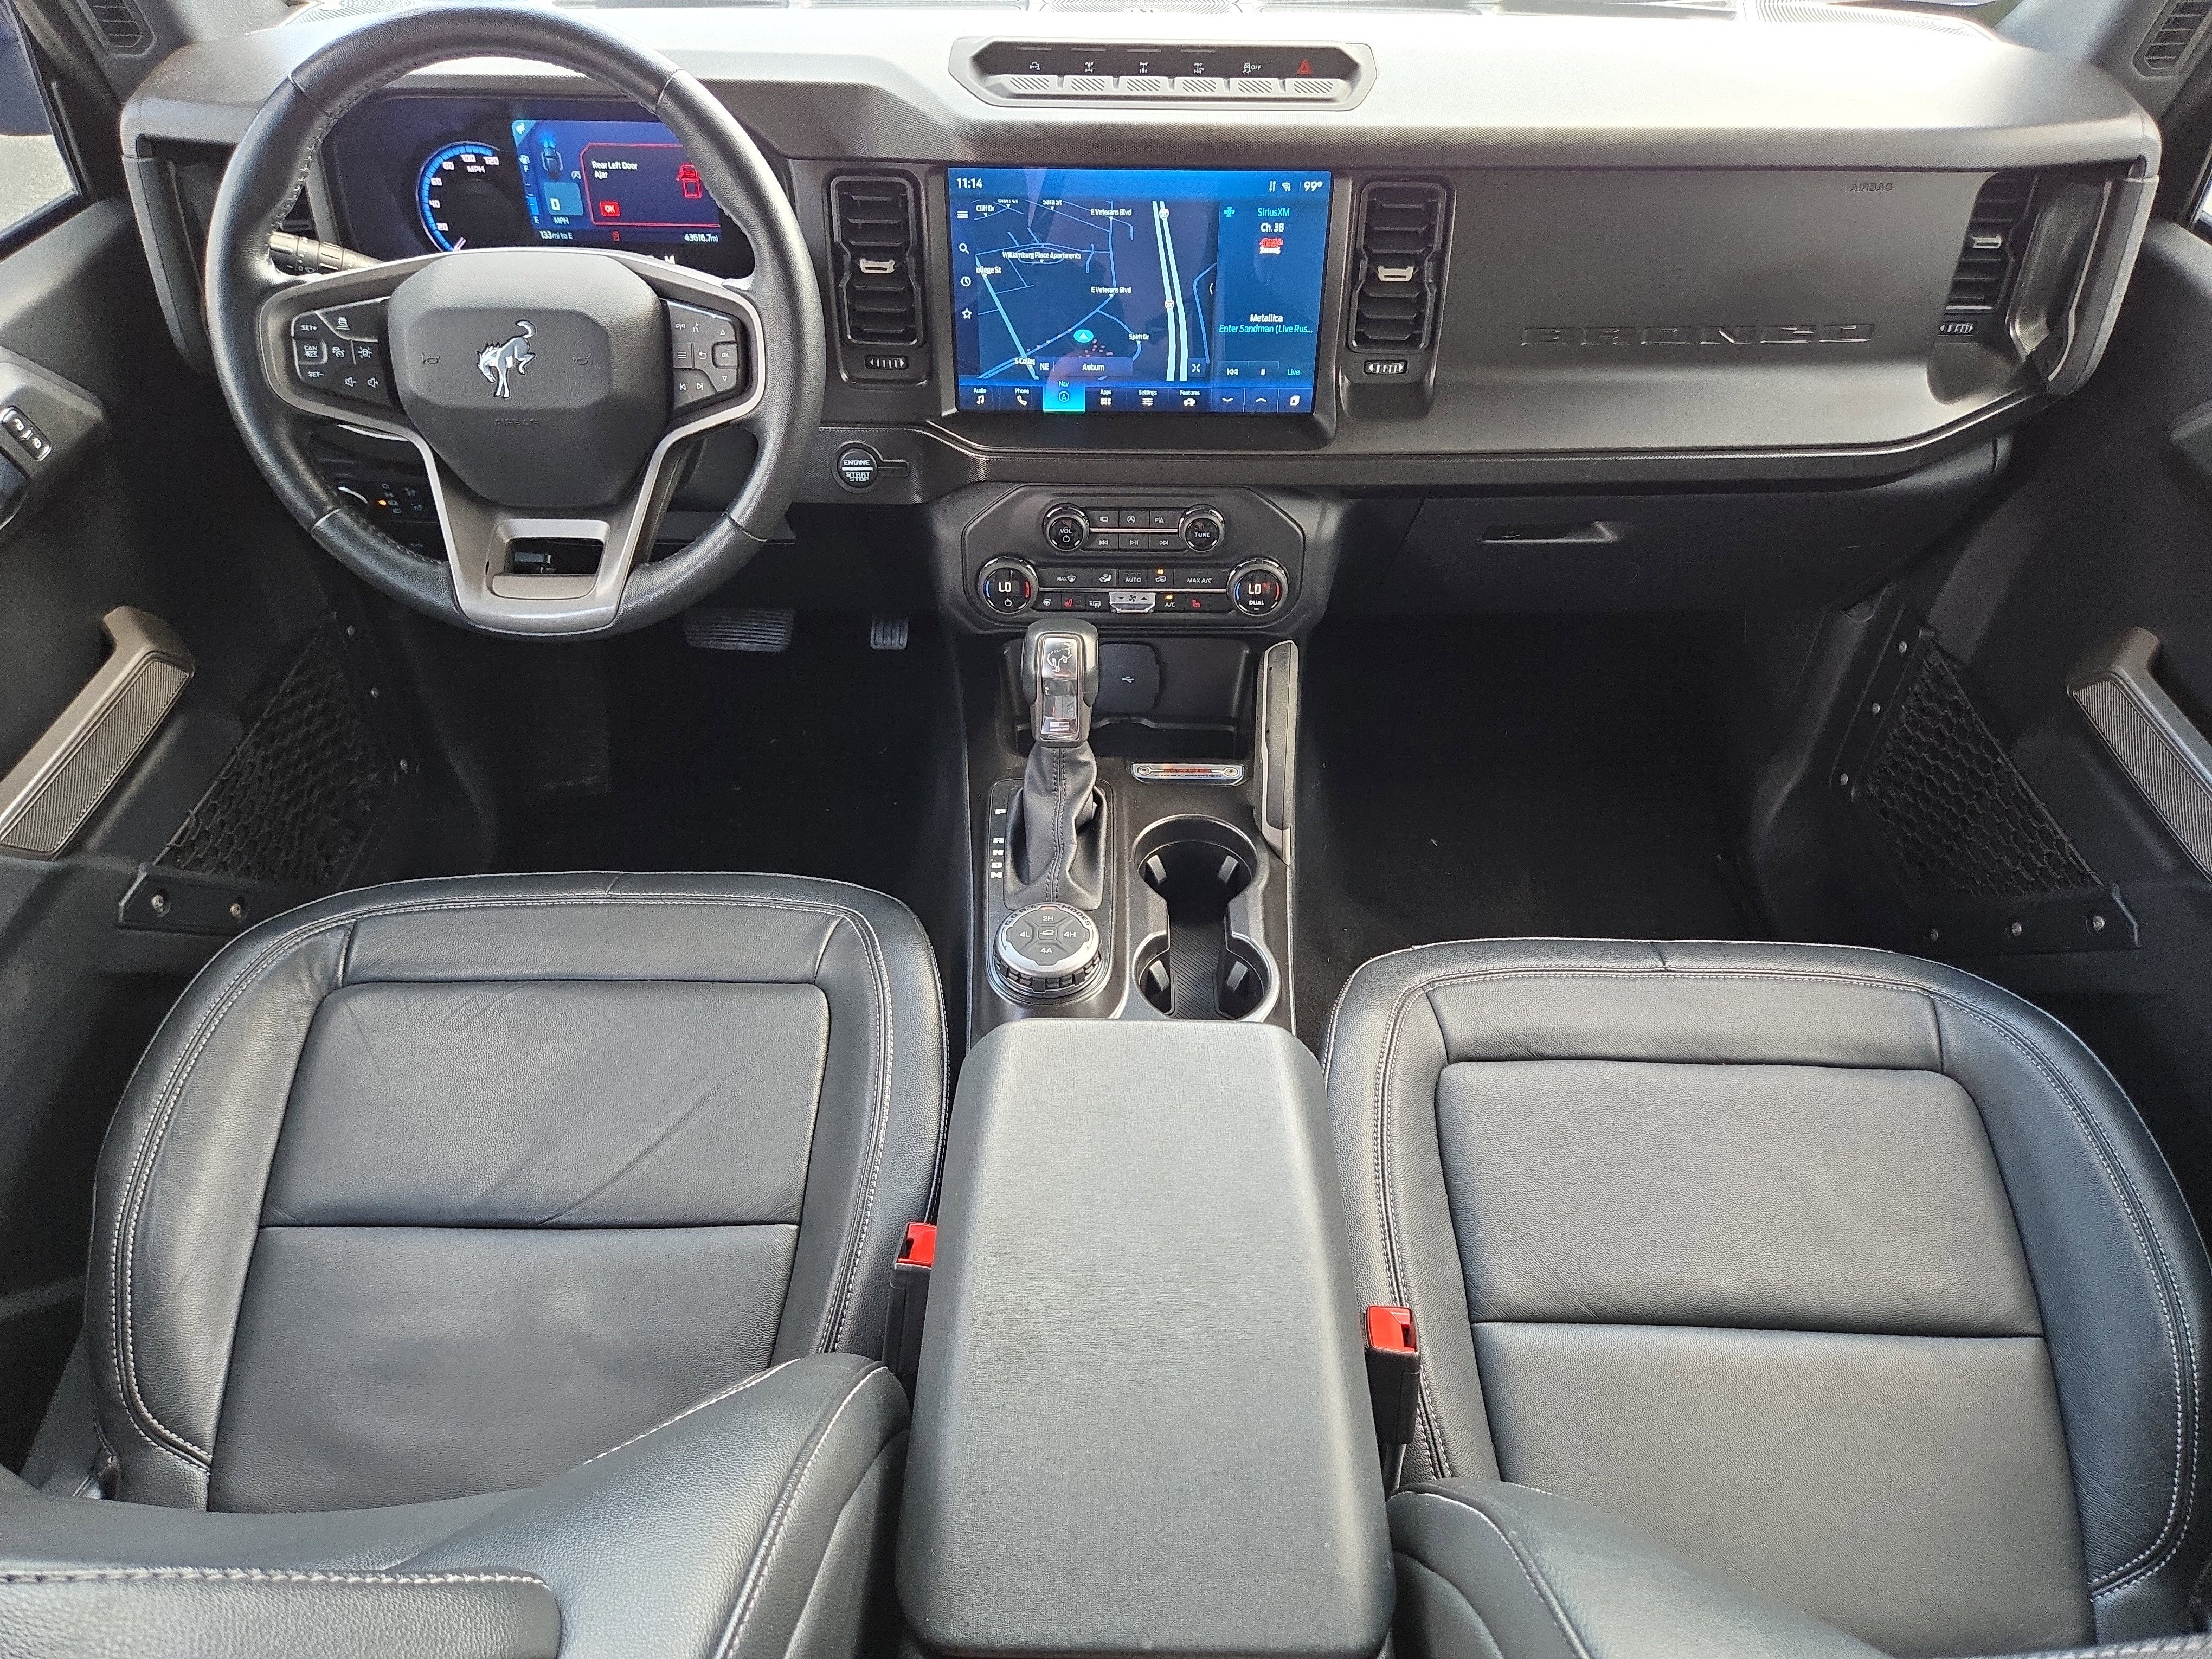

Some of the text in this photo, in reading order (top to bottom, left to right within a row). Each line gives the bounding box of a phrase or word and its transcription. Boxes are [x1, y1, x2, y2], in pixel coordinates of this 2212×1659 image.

[460, 154, 476, 163] 100
[483, 156, 499, 165] 120
[442, 162, 455, 170] 80
[591, 160, 638, 170] Rear Left Door
[594, 171, 608, 179] Ajar
[430, 178, 442, 186] 60
[956, 178, 983, 189] 11:14
[1304, 181, 1323, 191] 99°
[428, 200, 440, 208] 40
[550, 198, 561, 211] 0
[604, 205, 615, 213] OK
[1257, 207, 1290, 217] SiriusXM
[553, 217, 569, 225] MPH
[436, 223, 449, 231] 20
[1261, 222, 1284, 232] Ch. 38
[561, 231, 568, 239] to
[569, 232, 574, 240] E
[975, 266, 994, 274] ollege
[1250, 313, 1283, 323] Metallica
[1219, 324, 1239, 332] Enter
[1239, 324, 1274, 333] Sandman
[1275, 325, 1293, 334] (Live
[1521, 324, 1875, 346] BRONCO
[998, 582, 1012, 593] LO
[1248, 583, 1262, 594] LO
[1062, 904, 1092, 926] MODES
